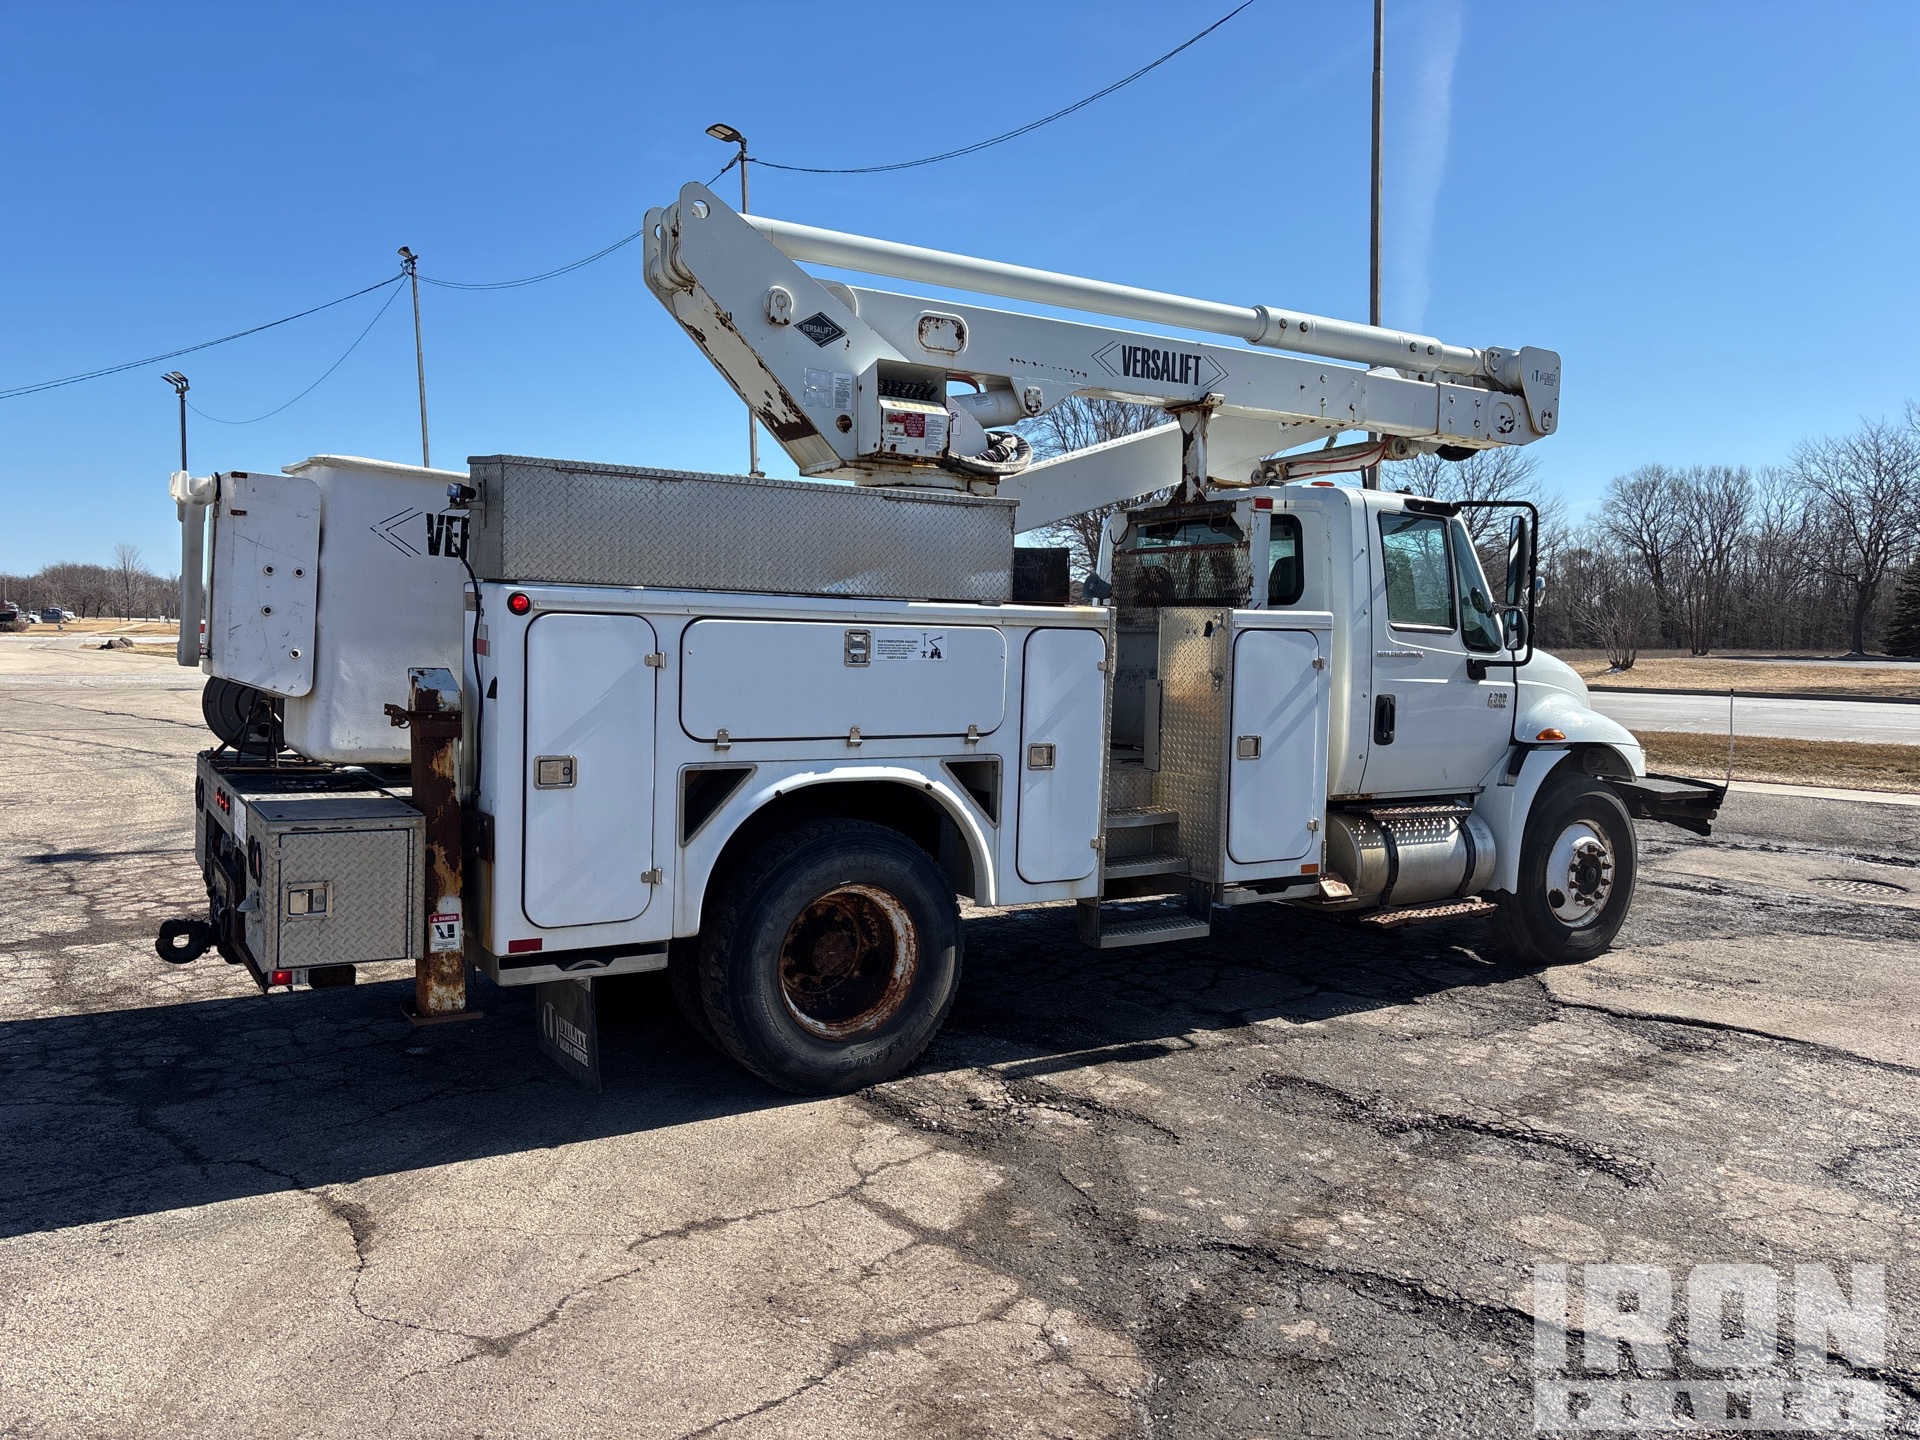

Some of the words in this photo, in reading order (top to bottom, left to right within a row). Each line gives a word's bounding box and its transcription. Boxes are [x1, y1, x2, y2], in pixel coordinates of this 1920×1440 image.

[802, 323, 832, 335] VERSALIFT
[1122, 344, 1201, 386] VERSALIFT
[558, 1016, 587, 1049] UTILITY
